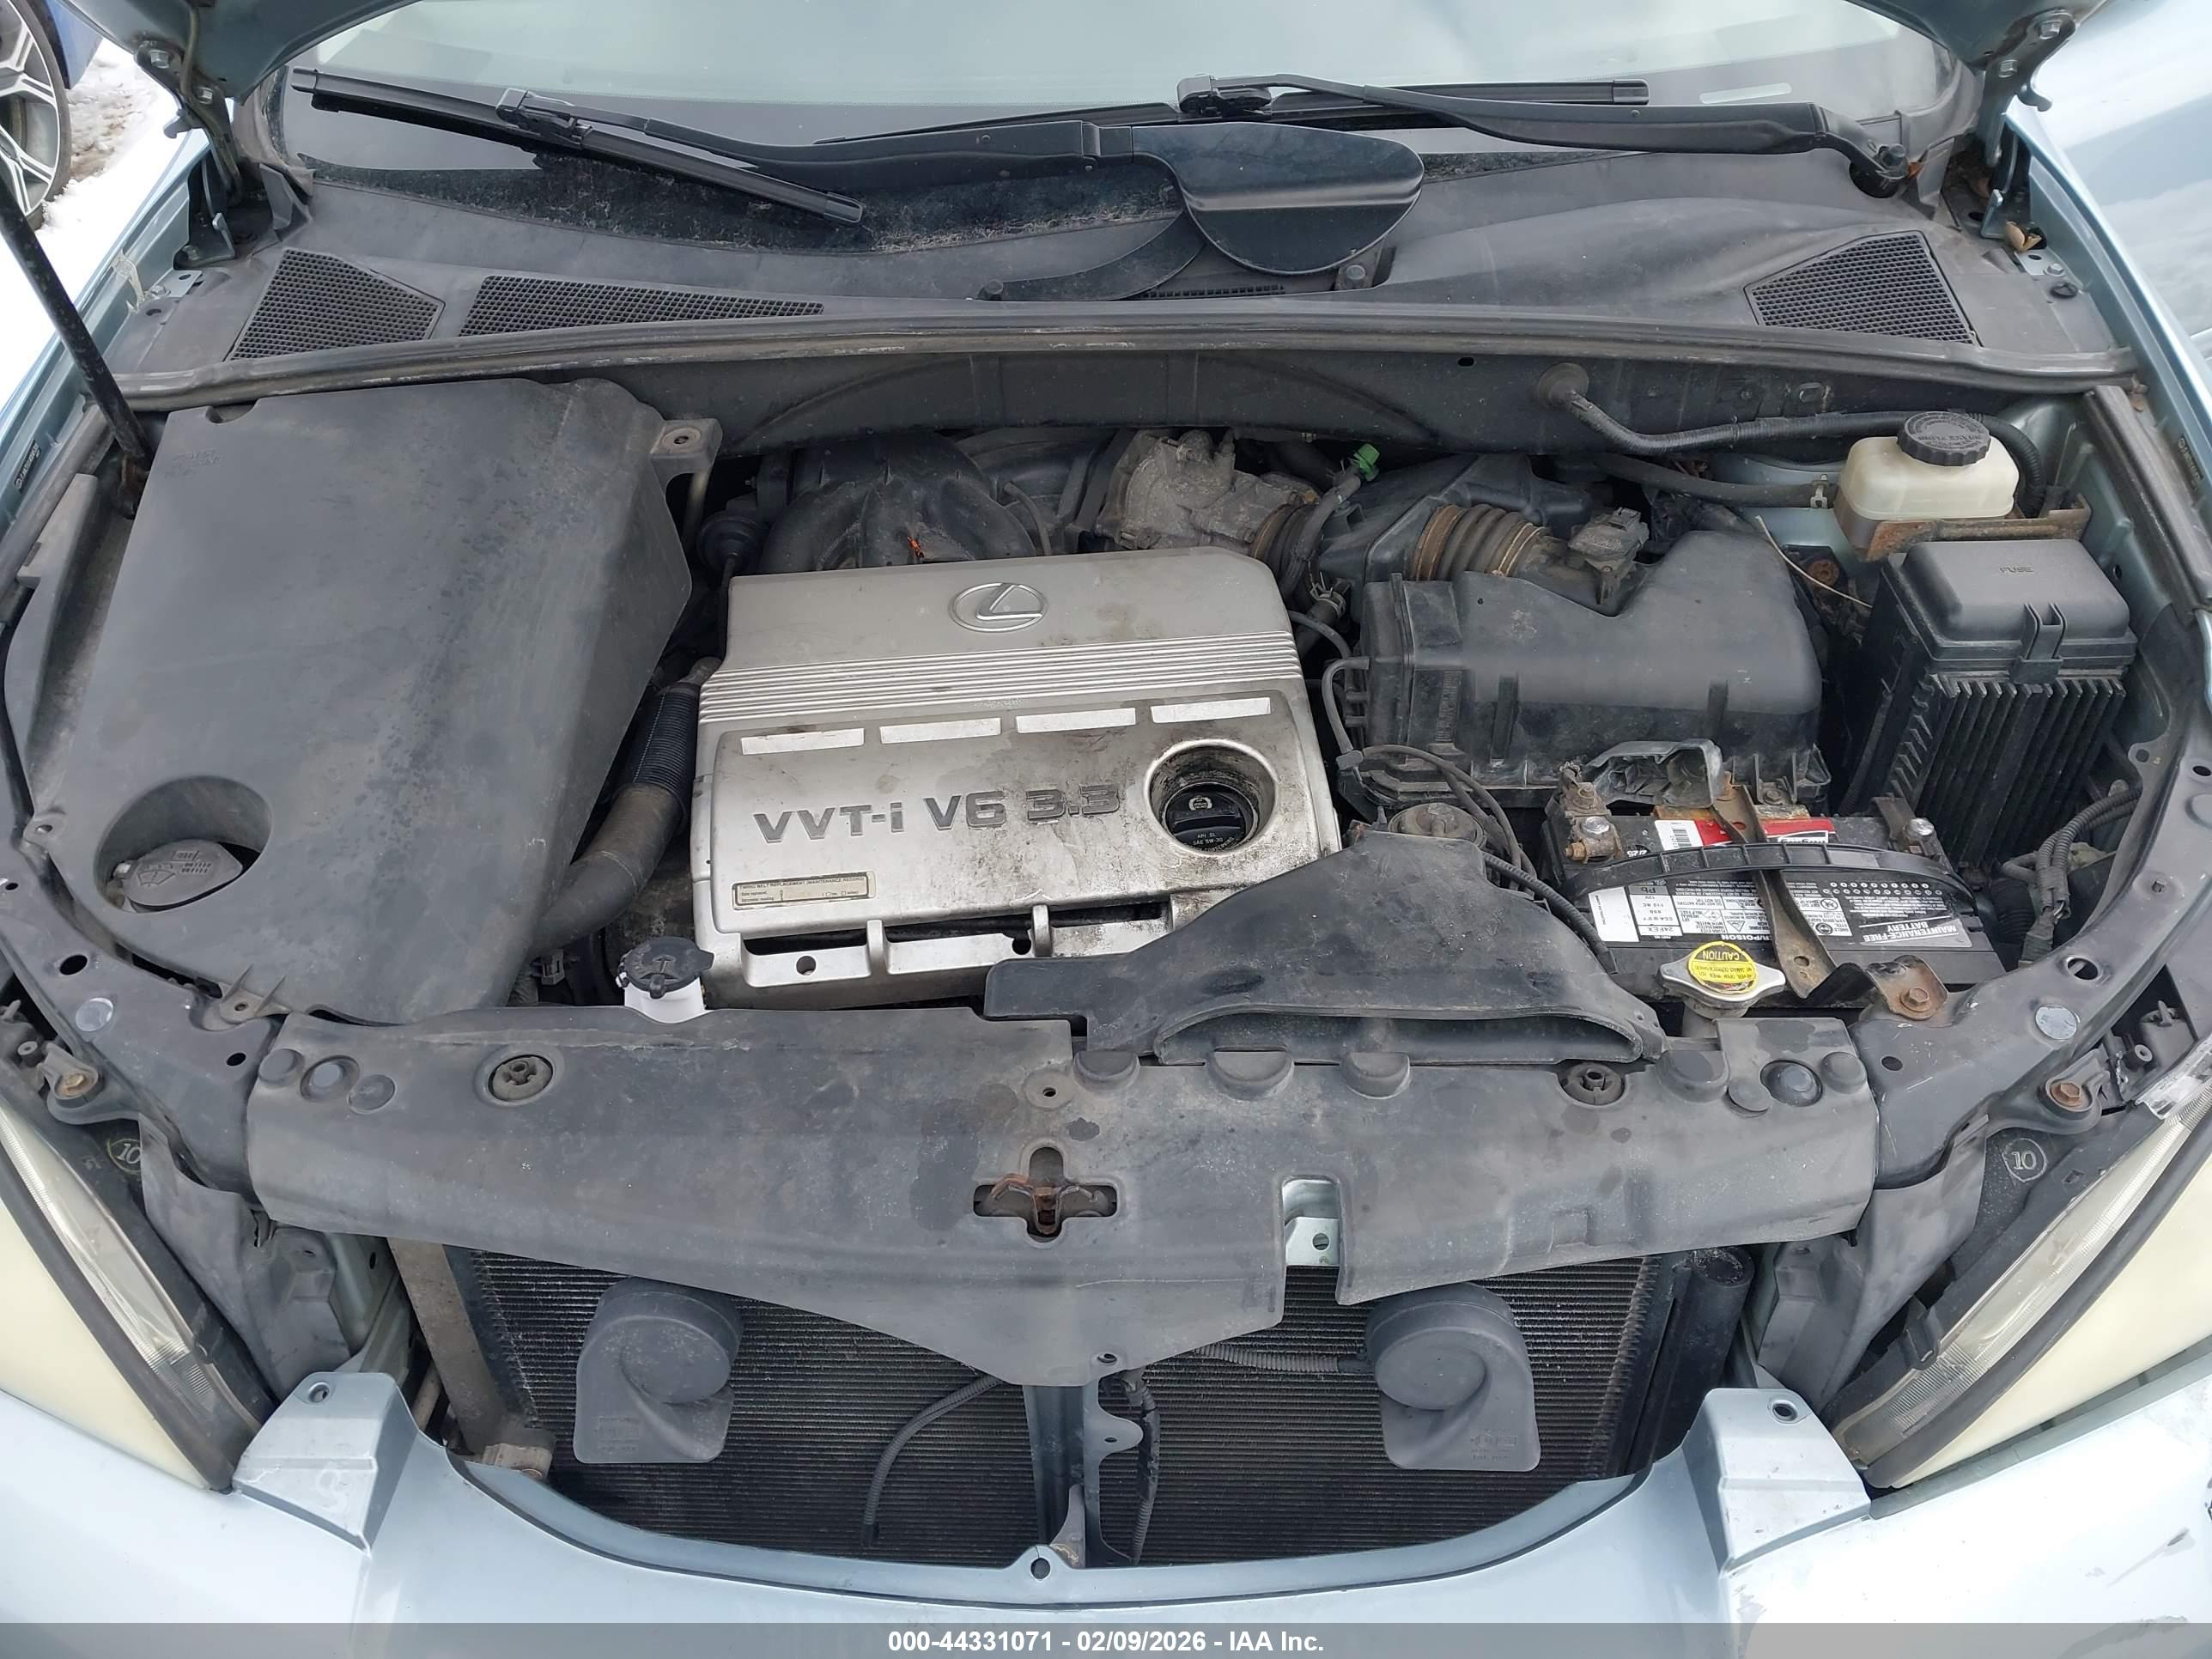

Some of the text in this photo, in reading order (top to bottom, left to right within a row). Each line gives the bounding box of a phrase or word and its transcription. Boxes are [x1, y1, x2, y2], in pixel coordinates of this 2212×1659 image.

[753, 784, 1121, 844] VVT-i V6 3.3
[1863, 925, 1957, 942] MAINTENANCE-FREE
[1887, 921, 1929, 932] BATTERY
[1702, 950, 1740, 960] CAUTION
[2011, 1151, 2036, 1170] 10
